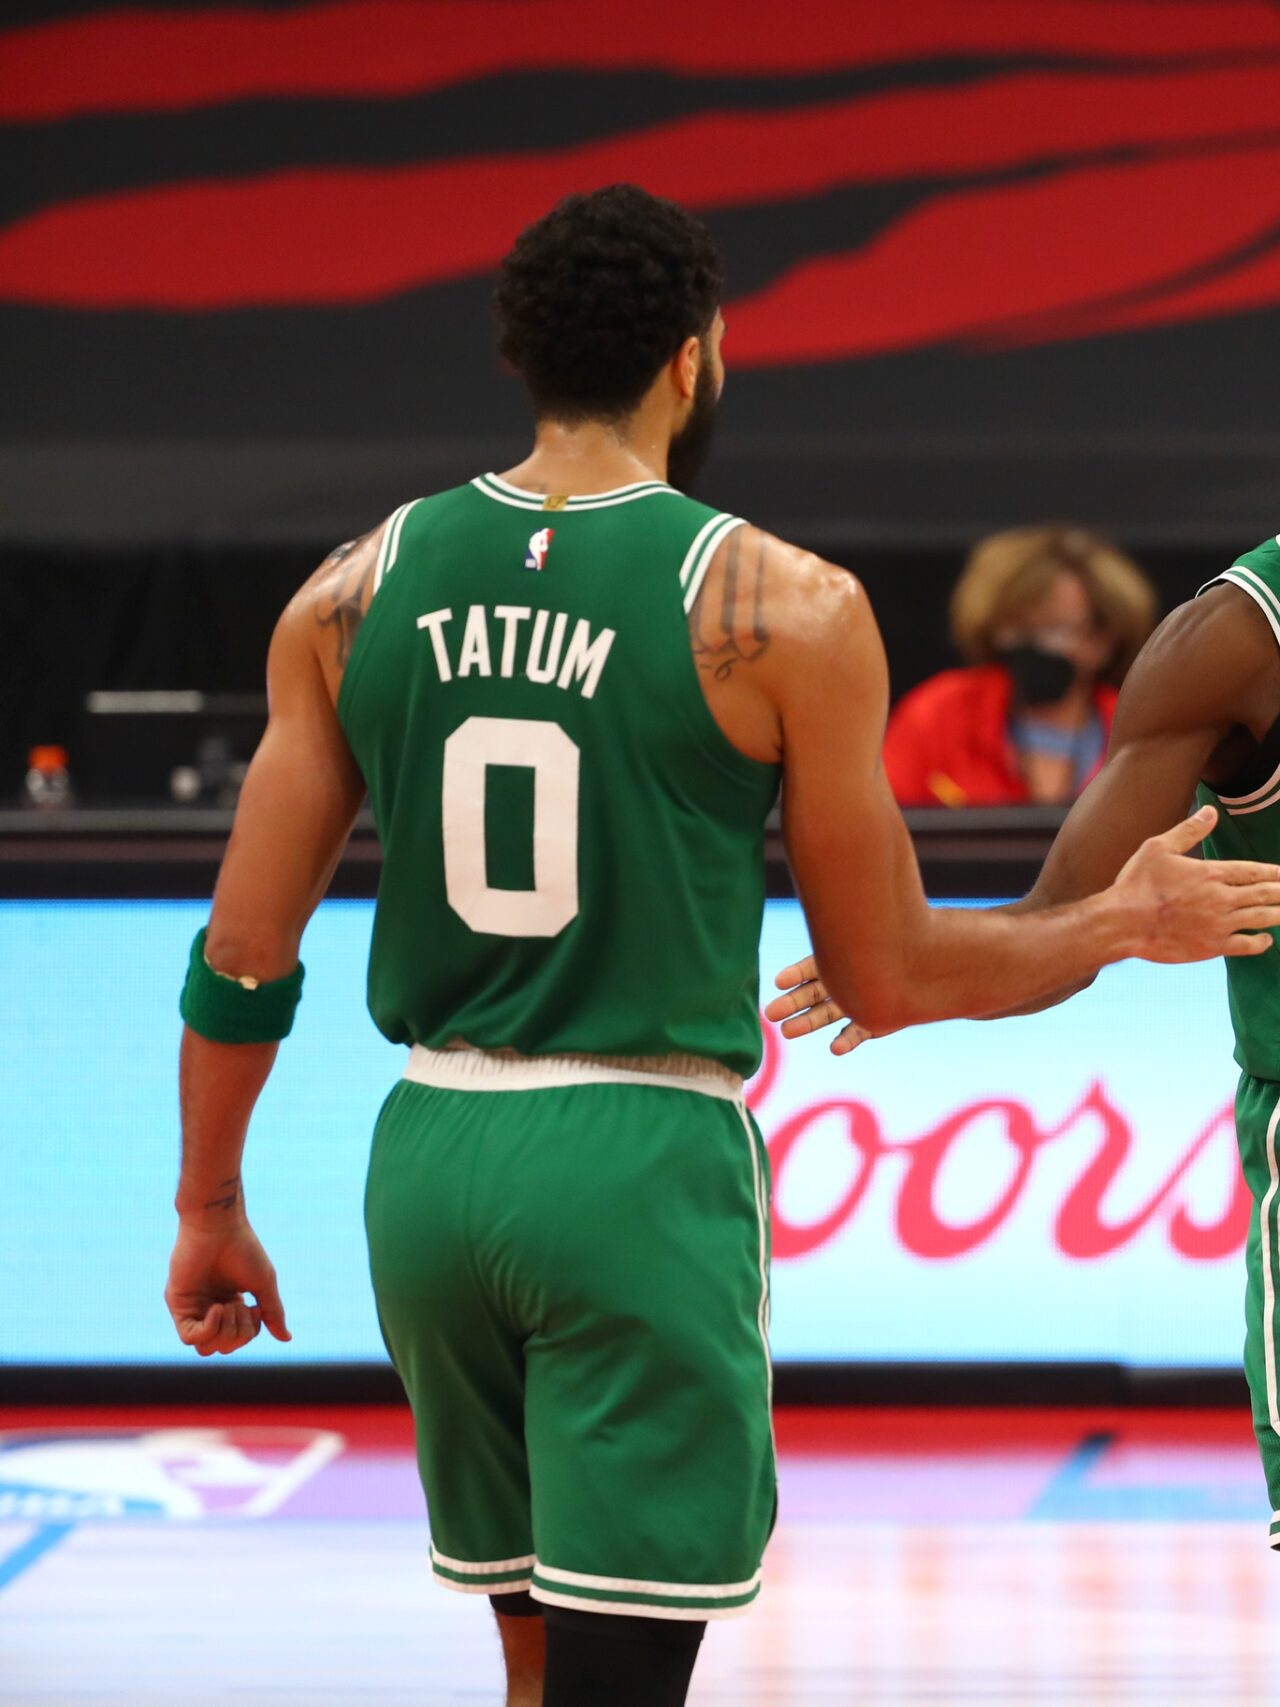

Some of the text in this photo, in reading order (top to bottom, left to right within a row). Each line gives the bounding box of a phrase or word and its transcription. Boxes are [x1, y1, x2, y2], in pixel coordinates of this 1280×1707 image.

[416, 604, 616, 699] TATUM
[442, 716, 580, 937] 0
[744, 1006, 1253, 1259] oors
